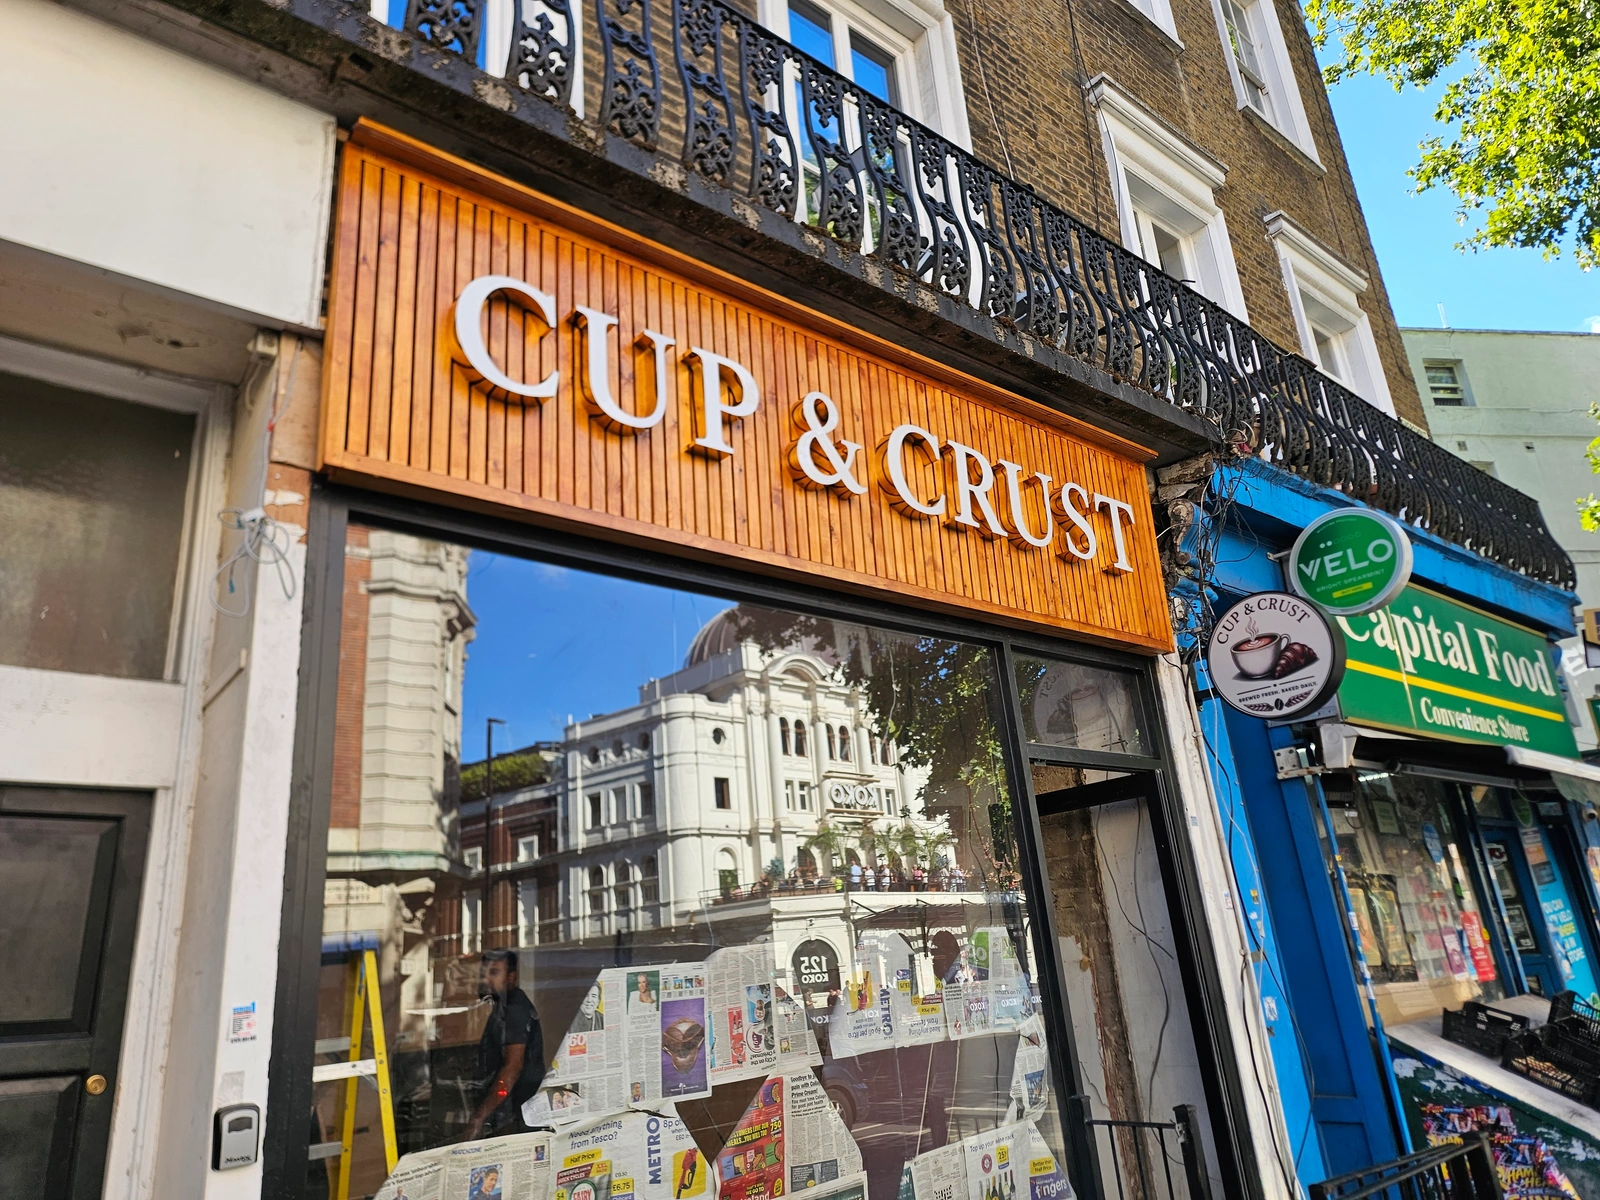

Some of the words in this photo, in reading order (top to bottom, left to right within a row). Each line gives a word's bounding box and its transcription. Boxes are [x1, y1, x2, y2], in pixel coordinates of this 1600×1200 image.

[455, 274, 760, 455] CUP
[796, 391, 868, 495] &
[887, 424, 1135, 573] CRUST
[1316, 581, 1342, 593] BRIGHT
[1343, 568, 1386, 585] SPEARMINT
[1216, 611, 1241, 645] CUP
[1244, 602, 1255, 616] &
[1257, 597, 1310, 624] CRUST
[1473, 627, 1557, 697] Food
[1238, 694, 1261, 703] BREWED
[1281, 685, 1300, 693] BAKED
[1419, 696, 1500, 737] Convenience
[1498, 714, 1530, 743] Store
[570, 1034, 586, 1047] 60
[790, 1073, 808, 1083] Goodbye
[807, 1073, 813, 1081] to
[790, 1083, 800, 1091] pain
[800, 1081, 809, 1089] with
[791, 1090, 803, 1098] Prime
[588, 1120, 623, 1134] anything
[663, 1119, 673, 1129] 8p
[770, 1120, 782, 1132] 750
[570, 1138, 589, 1150] from
[591, 1131, 618, 1145] Tesco?
[969, 1145, 978, 1153] Top
[985, 1140, 995, 1149] your
[1005, 1133, 1015, 1141] rack
[1494, 1133, 1513, 1144] FUN
[646, 1117, 661, 1184] METRO
[570, 1155, 581, 1164] Half
[581, 1152, 595, 1161] Price
[1032, 1160, 1045, 1168] Better
[1043, 1164, 1052, 1172] Price
[612, 1181, 631, 1192] £6.75
[1035, 1178, 1068, 1199] fingers
[573, 1189, 592, 1200] FAIRY
